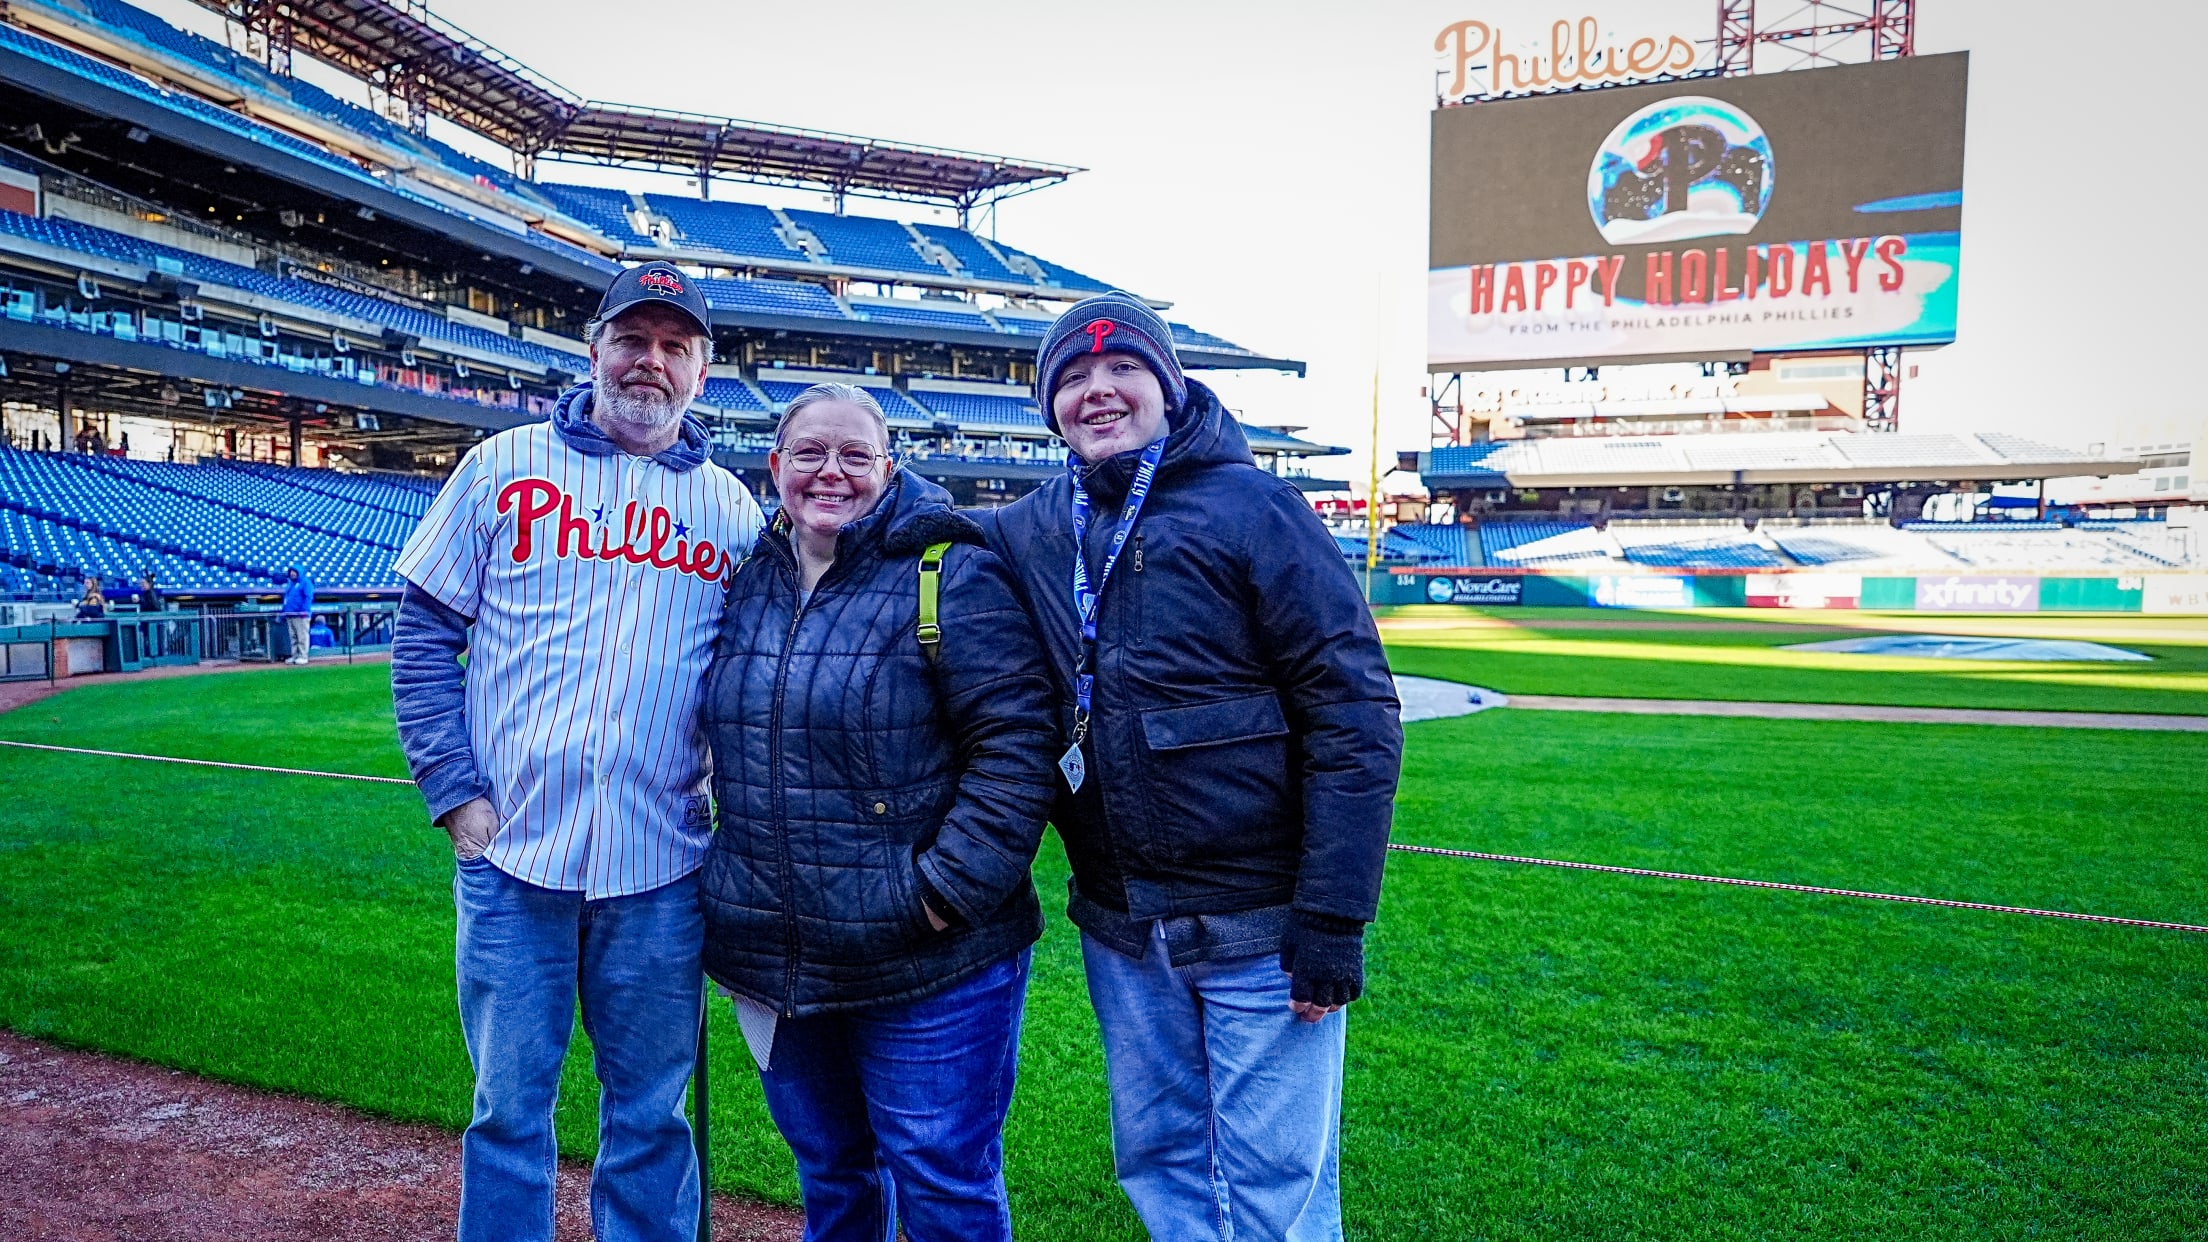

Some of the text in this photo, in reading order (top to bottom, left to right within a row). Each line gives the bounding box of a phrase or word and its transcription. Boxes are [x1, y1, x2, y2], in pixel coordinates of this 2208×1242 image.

[1434, 16, 1695, 96] Phillies
[639, 274, 684, 294] Phillies
[1470, 235, 1906, 314] HAPPY HOLIDAYS
[1087, 319, 1114, 352] P
[1509, 306, 1854, 335] FROM THE PHILADELPHIA PHILLIES
[1131, 459, 1155, 498] PHILLY
[497, 478, 733, 592] Phillies
[1921, 576, 2033, 608] xfinity
